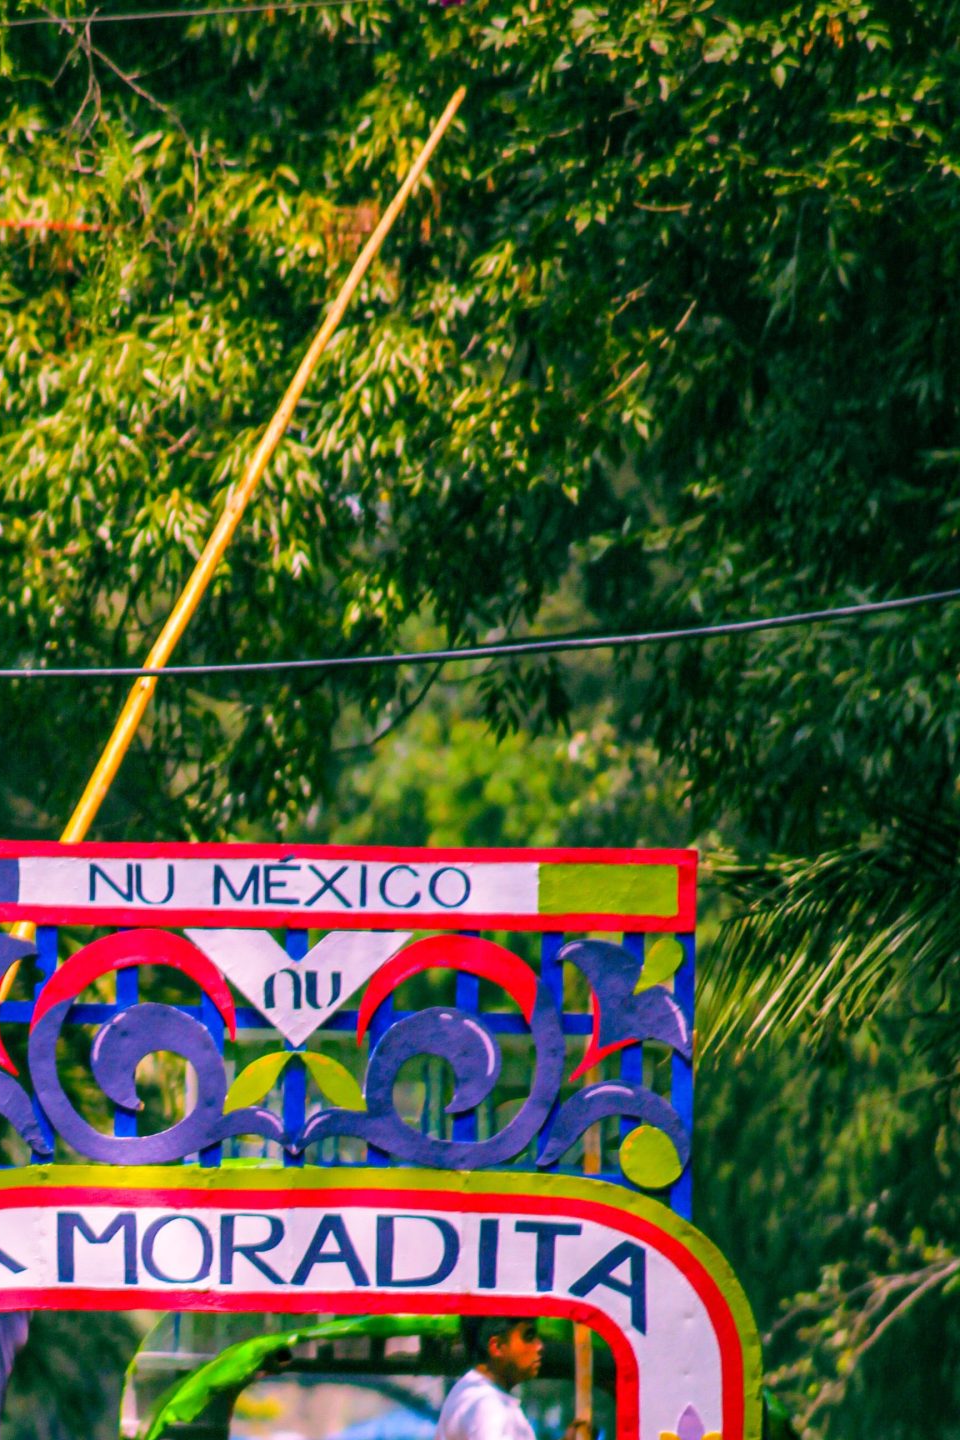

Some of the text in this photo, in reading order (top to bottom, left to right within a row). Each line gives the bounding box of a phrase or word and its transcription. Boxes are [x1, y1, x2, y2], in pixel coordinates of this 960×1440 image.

[88, 855, 472, 909] NU MÉXICO
[56, 1212, 648, 1337] MORADITA
